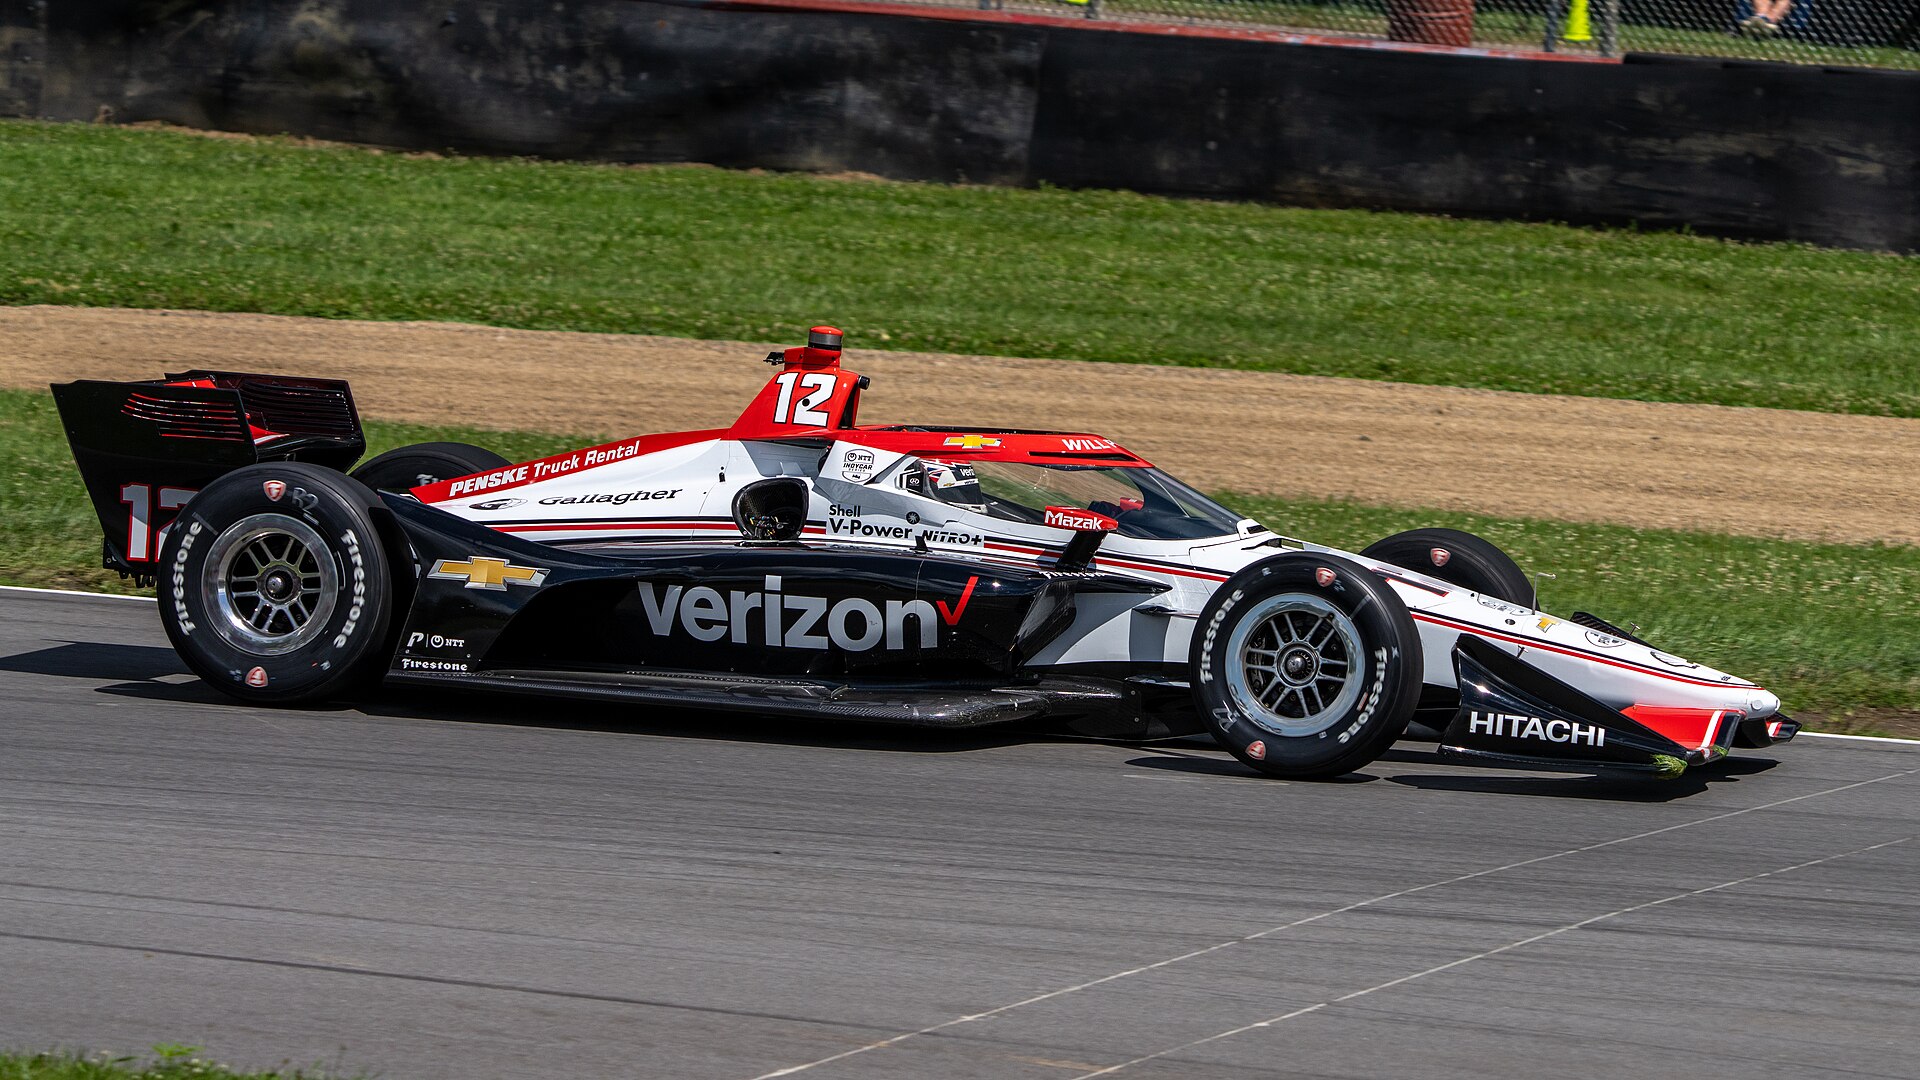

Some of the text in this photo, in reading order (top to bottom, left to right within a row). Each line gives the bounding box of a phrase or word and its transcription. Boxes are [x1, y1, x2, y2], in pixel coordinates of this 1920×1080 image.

[773, 372, 837, 426] 12
[1062, 439, 1110, 450] WILL
[449, 466, 529, 497] PENSKE
[533, 455, 579, 478] Truck
[584, 441, 640, 466] Rental
[538, 488, 683, 506] Gallagher
[829, 504, 861, 517] Shell
[829, 518, 912, 539] V-Power
[1045, 510, 1103, 530] Mazak
[172, 521, 203, 636] Firestone
[334, 528, 366, 648] Firestone
[638, 574, 938, 652] verizon
[445, 638, 465, 647] NTT
[1200, 589, 1245, 685] Firestone
[401, 658, 468, 671] Firestone
[1337, 646, 1388, 744] Firestone
[1469, 711, 1605, 747] HITACHI
